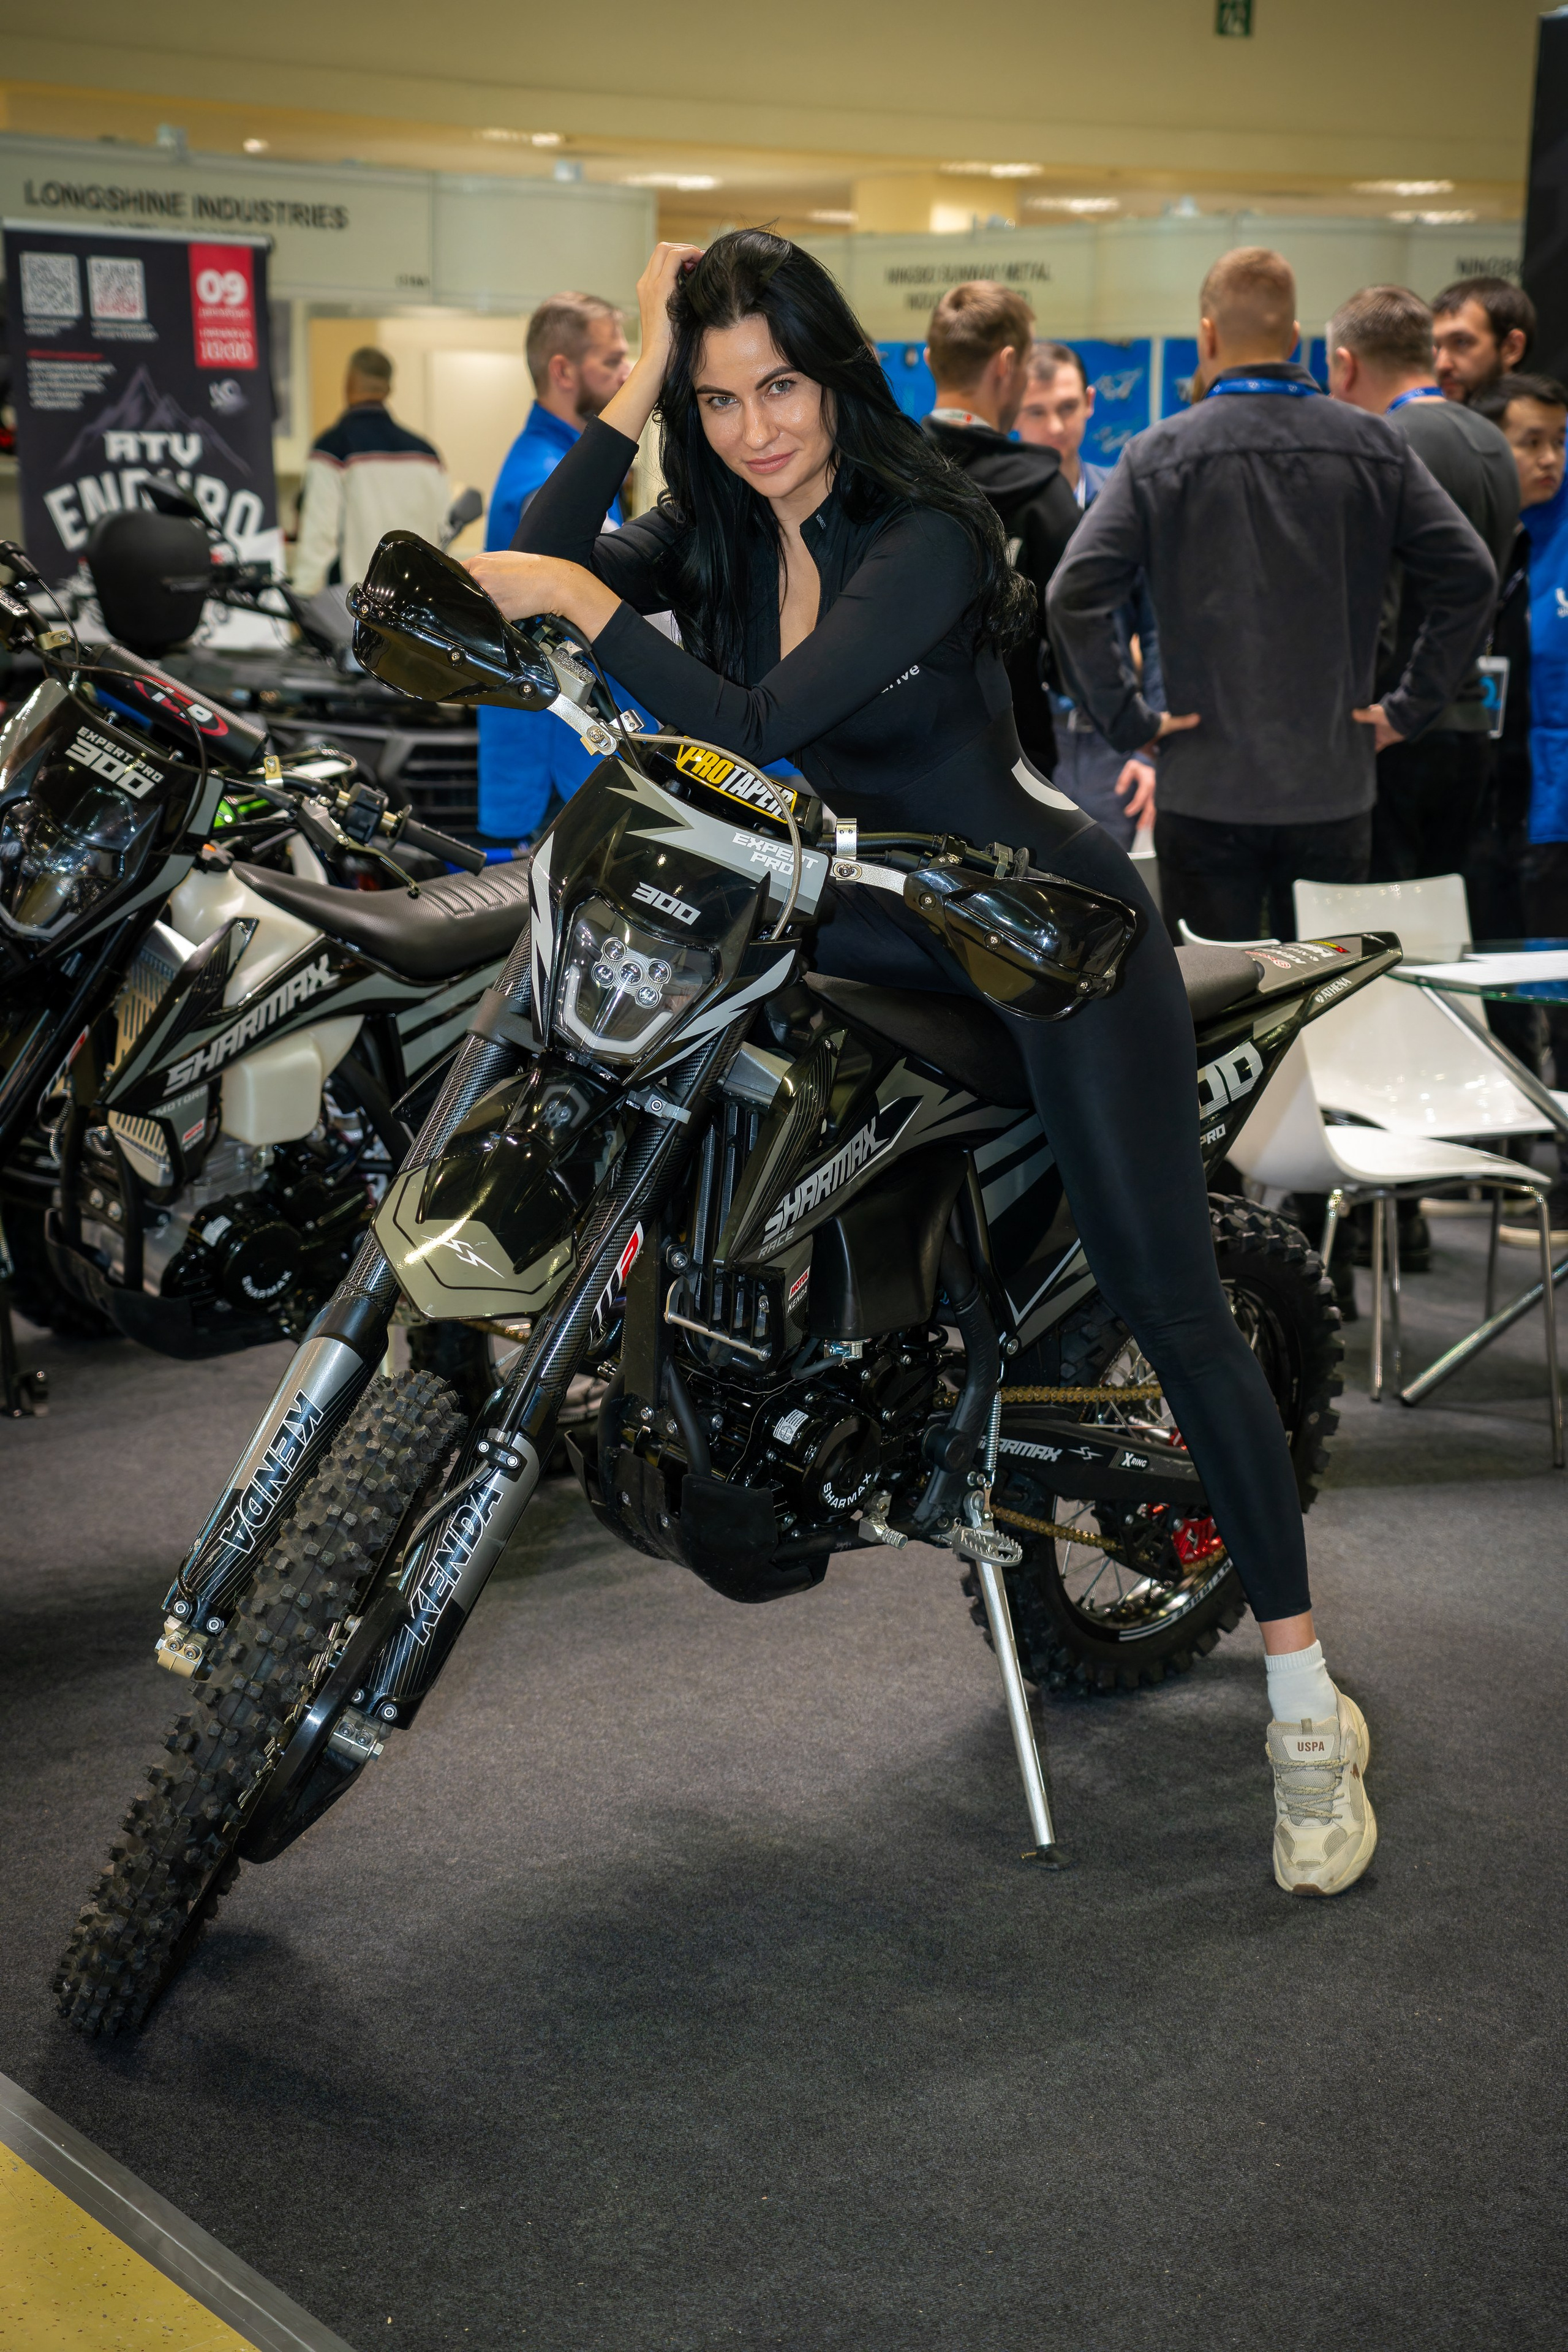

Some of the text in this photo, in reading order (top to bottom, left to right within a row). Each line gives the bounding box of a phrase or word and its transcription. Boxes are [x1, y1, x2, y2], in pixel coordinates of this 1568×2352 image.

[24, 179, 187, 217] LONGSHINE
[193, 194, 350, 230] INDUSTRIES
[196, 268, 248, 306] 09
[103, 430, 203, 467] ATV
[43, 467, 265, 551] ENDRO
[881, 665, 920, 693] ive
[64, 736, 156, 799] 300
[77, 726, 165, 784] EXPERT PRO
[750, 851, 794, 875] PRO
[631, 882, 701, 925] 300
[1321, 977, 1352, 1000] ATHENA
[162, 953, 341, 1096] SHARMAX
[1197, 1041, 1263, 1120] 00
[1200, 1123, 1226, 1148] PRO
[763, 1117, 889, 1245] SHARMAX
[757, 1227, 795, 1260] RACE
[787, 1285, 807, 1313] KENDA
[790, 1270, 809, 1296] MOTUL
[219, 1389, 324, 1554] KENDA
[823, 1473, 872, 1509] SHARMAX
[405, 1479, 504, 1646] KENDA
[1297, 1741, 1325, 1752] USPA
